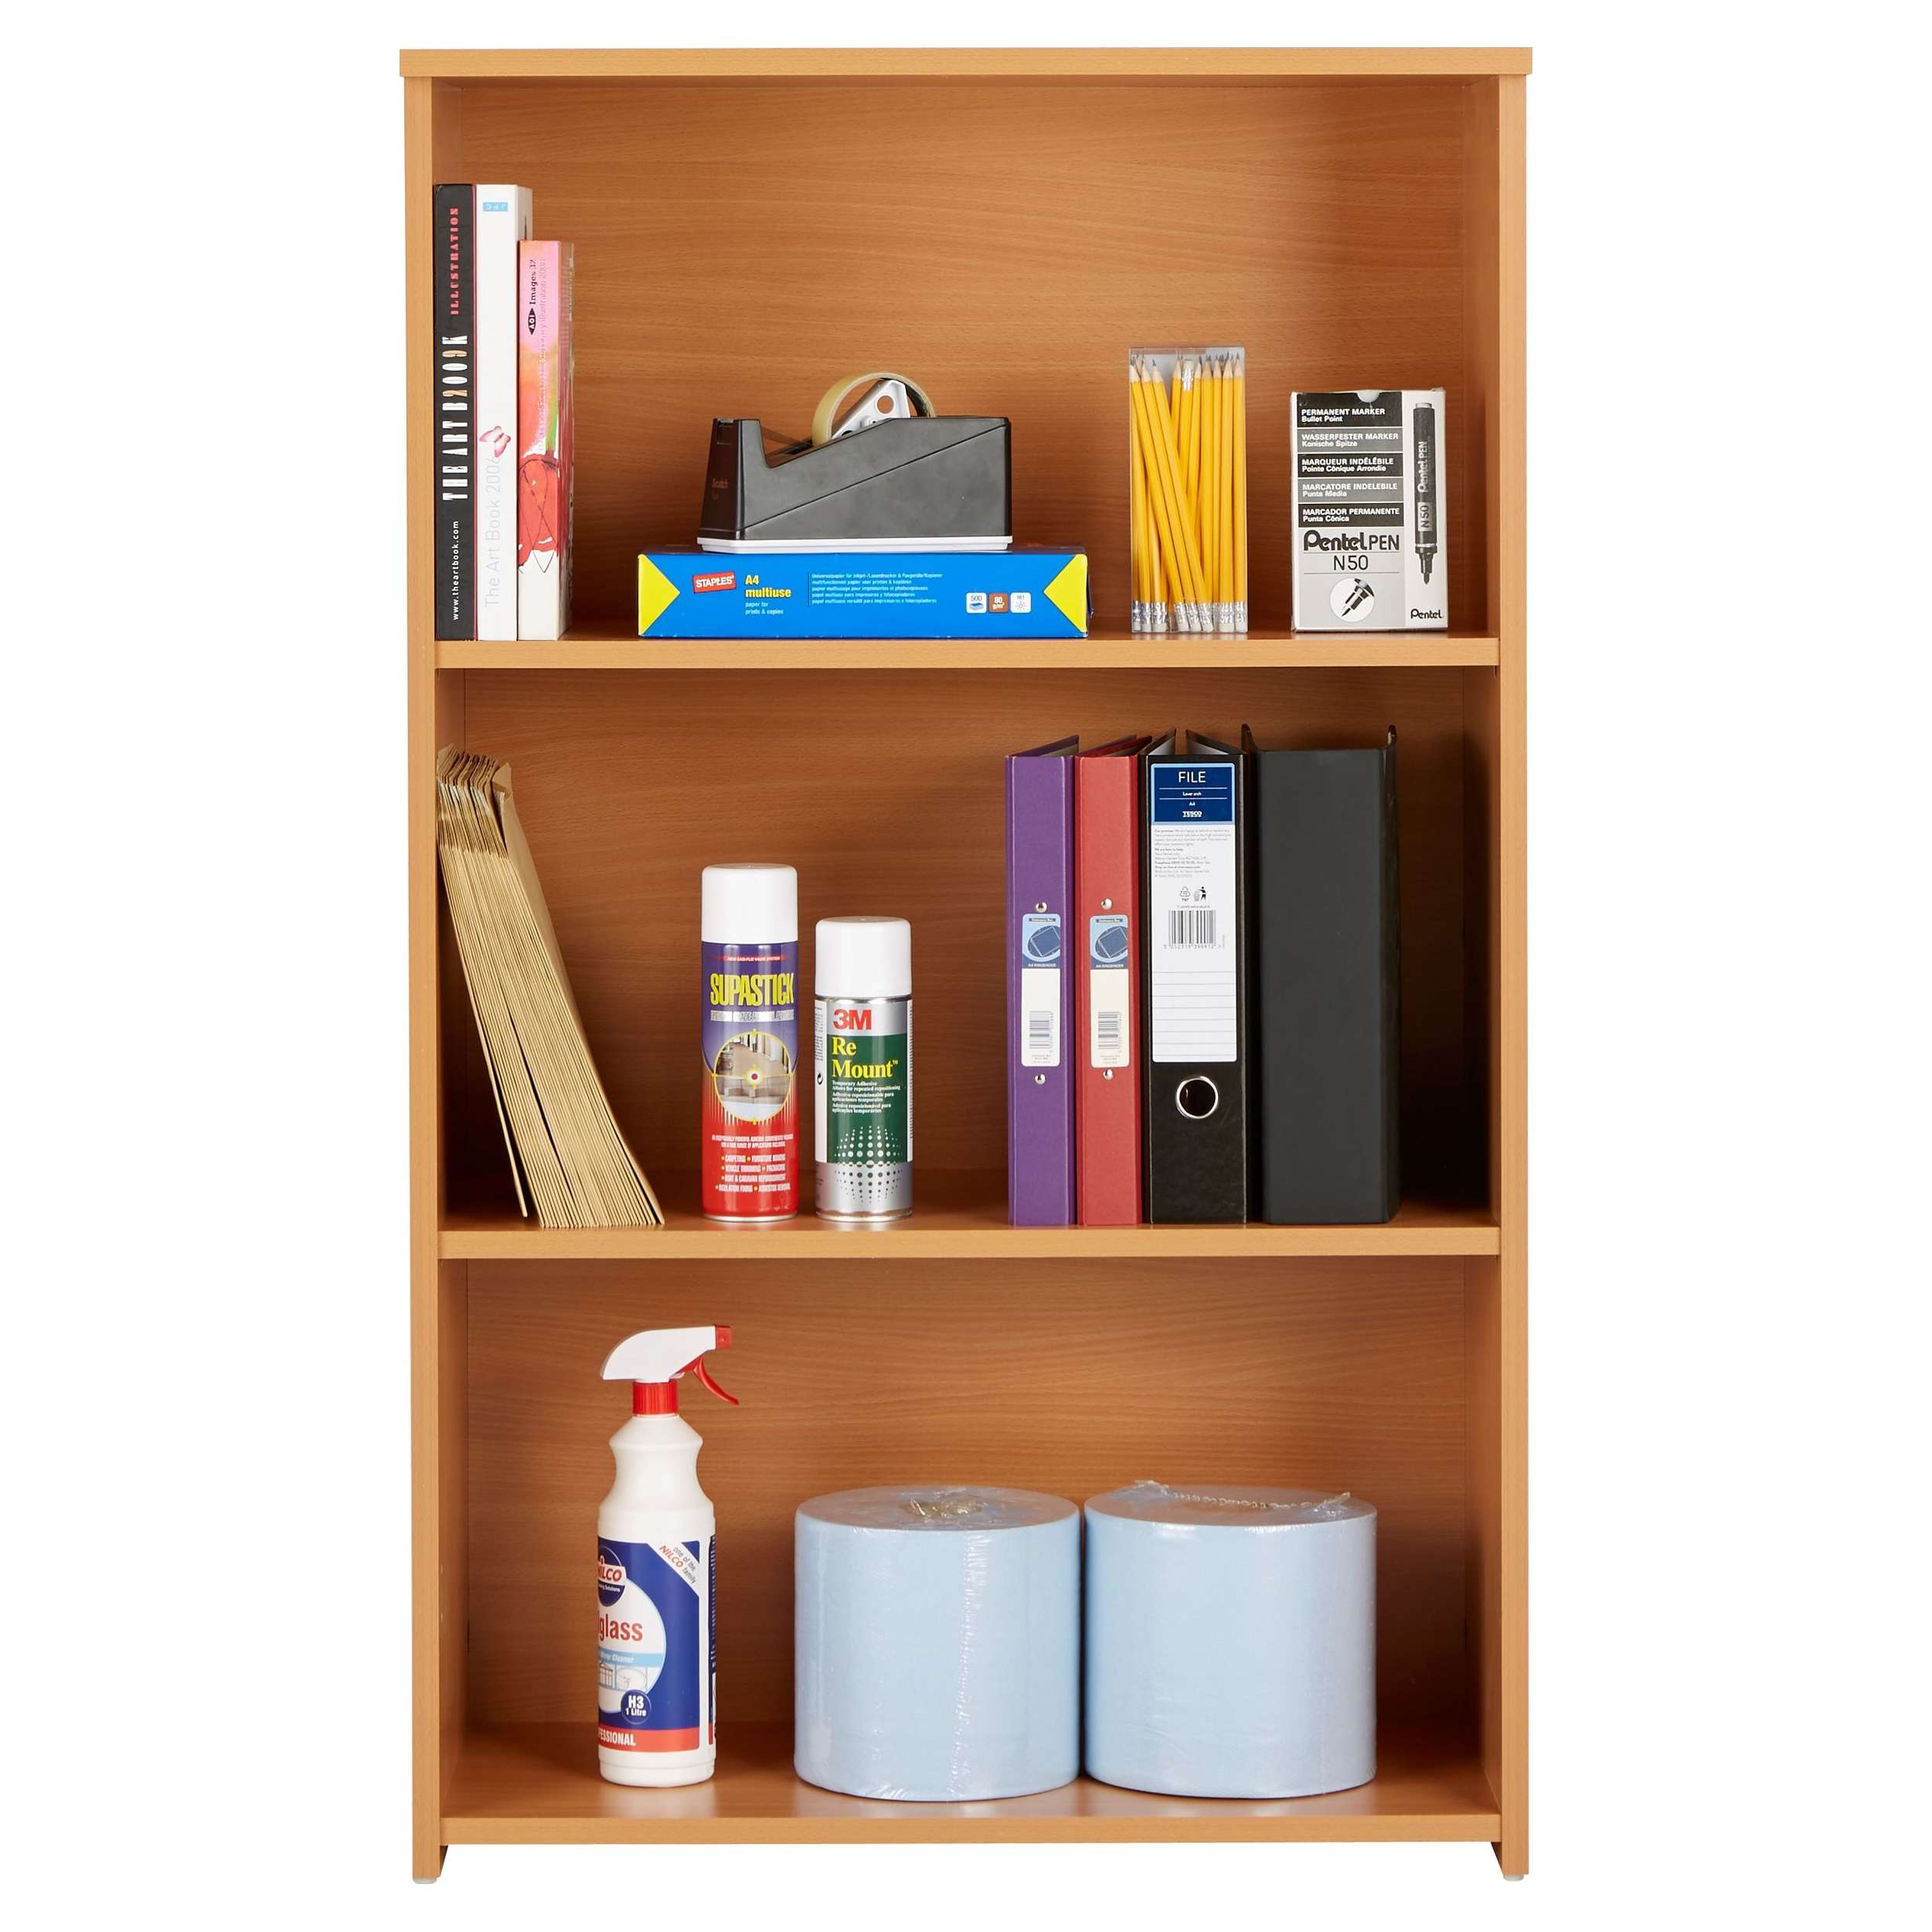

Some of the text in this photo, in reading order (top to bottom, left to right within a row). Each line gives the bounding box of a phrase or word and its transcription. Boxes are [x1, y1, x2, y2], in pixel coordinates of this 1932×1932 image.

[450, 208, 460, 315] ILLUSTRATION
[529, 271, 539, 305] Images
[442, 420, 468, 456] ART
[442, 465, 468, 501] THE
[485, 498, 501, 541] Book
[485, 546, 501, 573] Art
[696, 576, 733, 588] STAPLES
[745, 574, 759, 585] A4
[485, 577, 501, 607] The
[745, 587, 791, 597] multiuse
[1410, 608, 1442, 619] Pentel
[1178, 771, 1206, 783] FILE
[710, 972, 794, 1007] SUPASTICK
[833, 1009, 872, 1030] 3M
[832, 1036, 857, 1056] Re
[659, 1546, 684, 1567] NILCO
[597, 1611, 643, 1641] glass
[628, 1695, 645, 1709] H3
[631, 1708, 647, 1716] Litre
